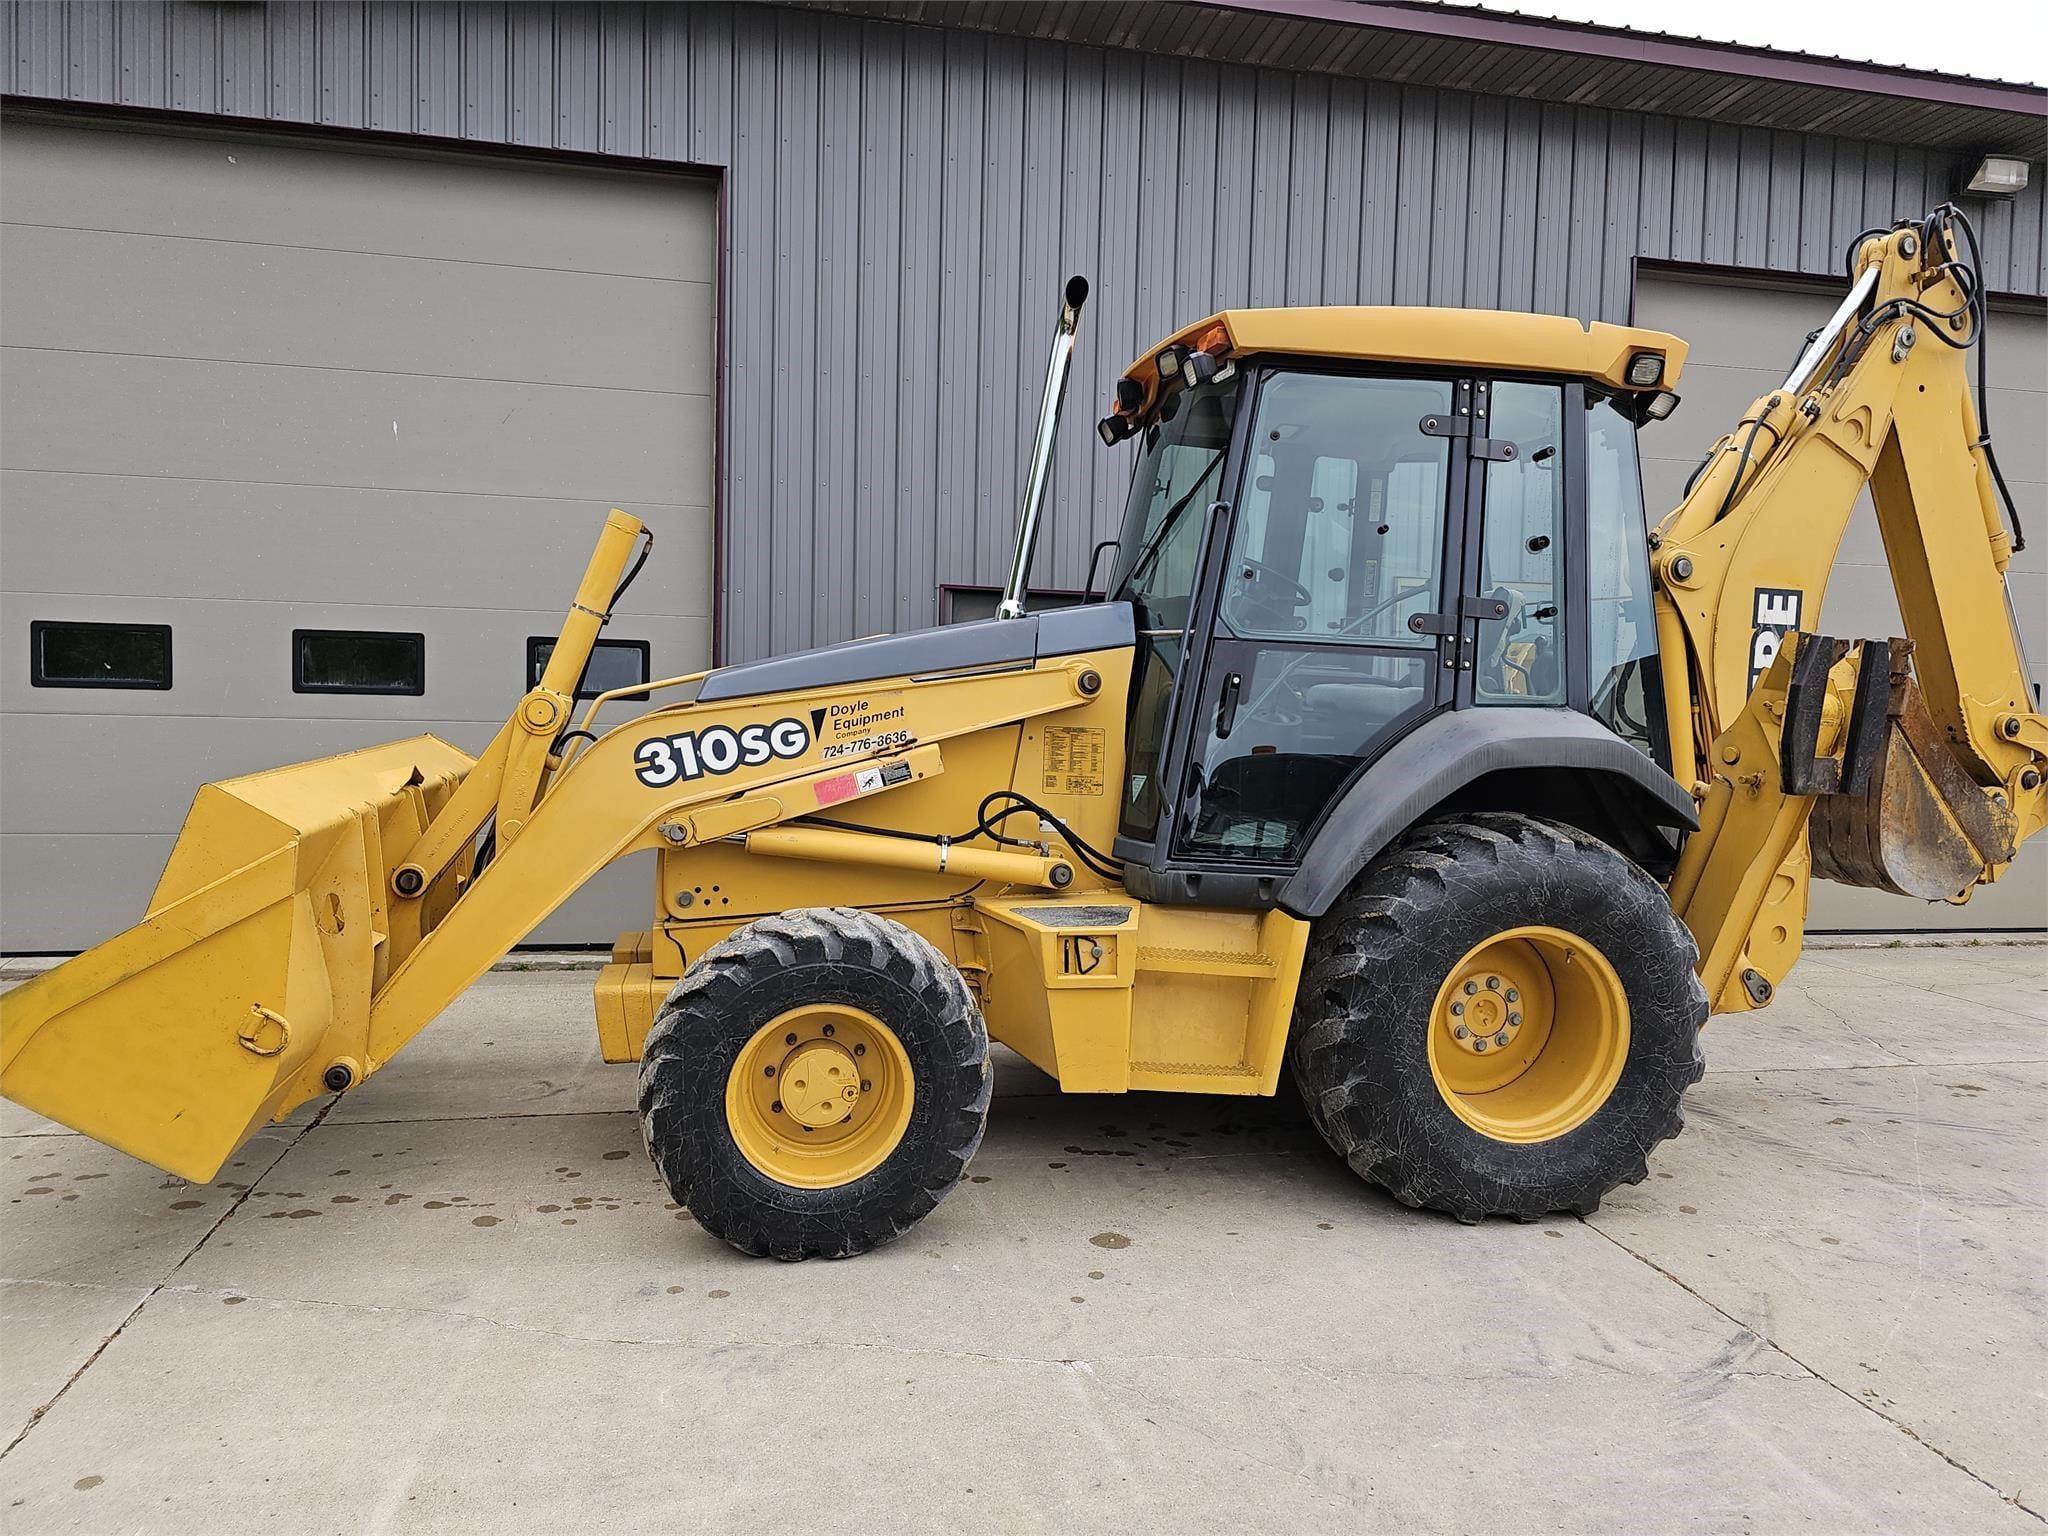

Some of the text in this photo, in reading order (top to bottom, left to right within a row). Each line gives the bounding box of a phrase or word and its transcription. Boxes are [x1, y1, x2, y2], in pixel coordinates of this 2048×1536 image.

[830, 700, 869, 717] Doyle
[833, 706, 904, 730] Equipment
[823, 730, 907, 759] 724-776-3636
[835, 727, 871, 739] Company
[634, 718, 810, 788] 310SG
